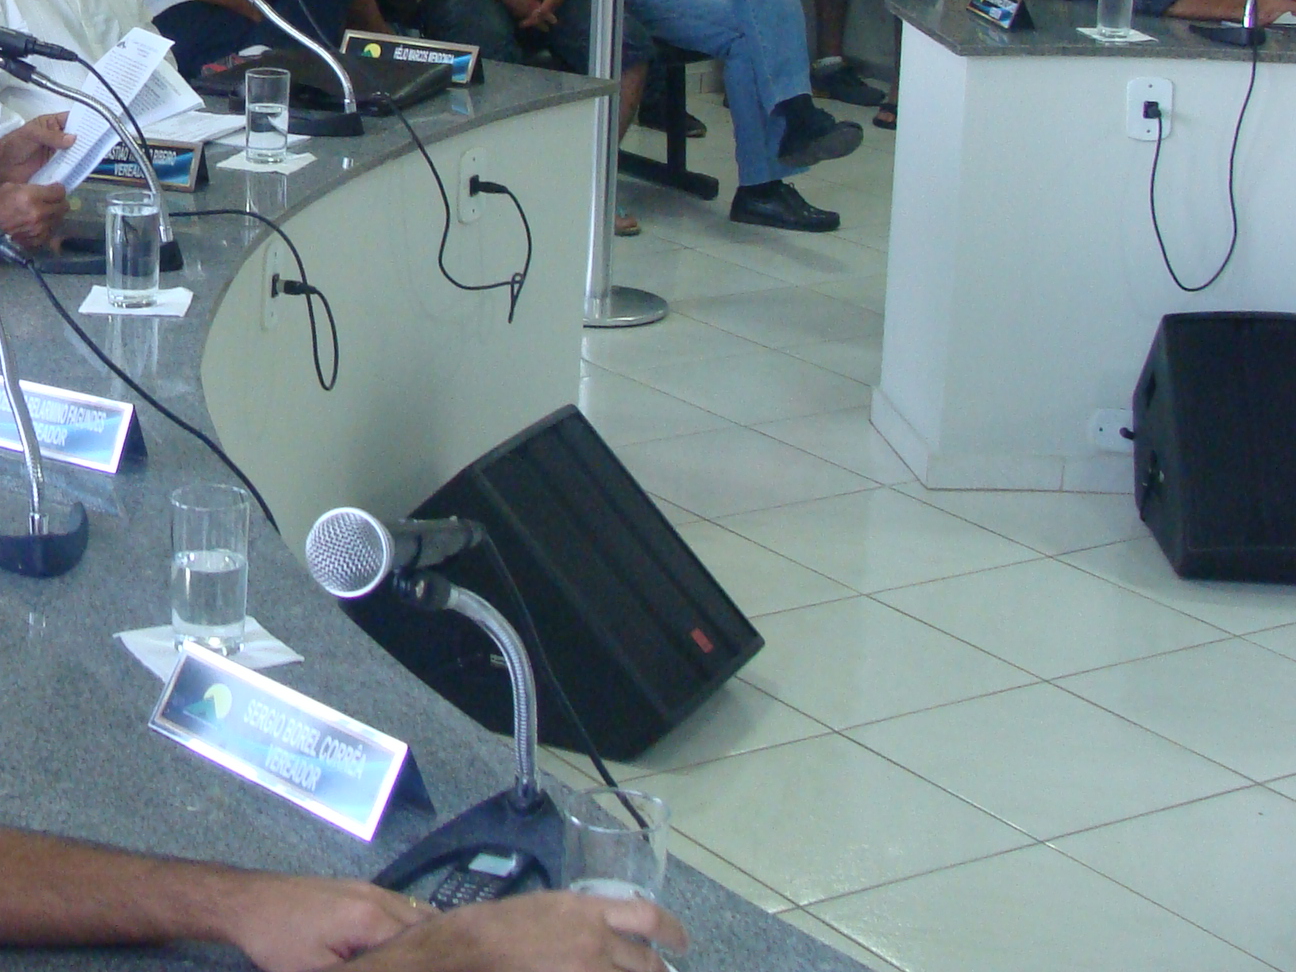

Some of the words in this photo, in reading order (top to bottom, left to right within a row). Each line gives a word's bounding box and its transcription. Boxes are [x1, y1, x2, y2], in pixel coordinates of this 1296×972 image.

[66, 403, 108, 434] FAGUNDES
[264, 743, 322, 793] VEREADOR
[282, 716, 322, 759] BOREL
[318, 734, 367, 780] CORRÊA
